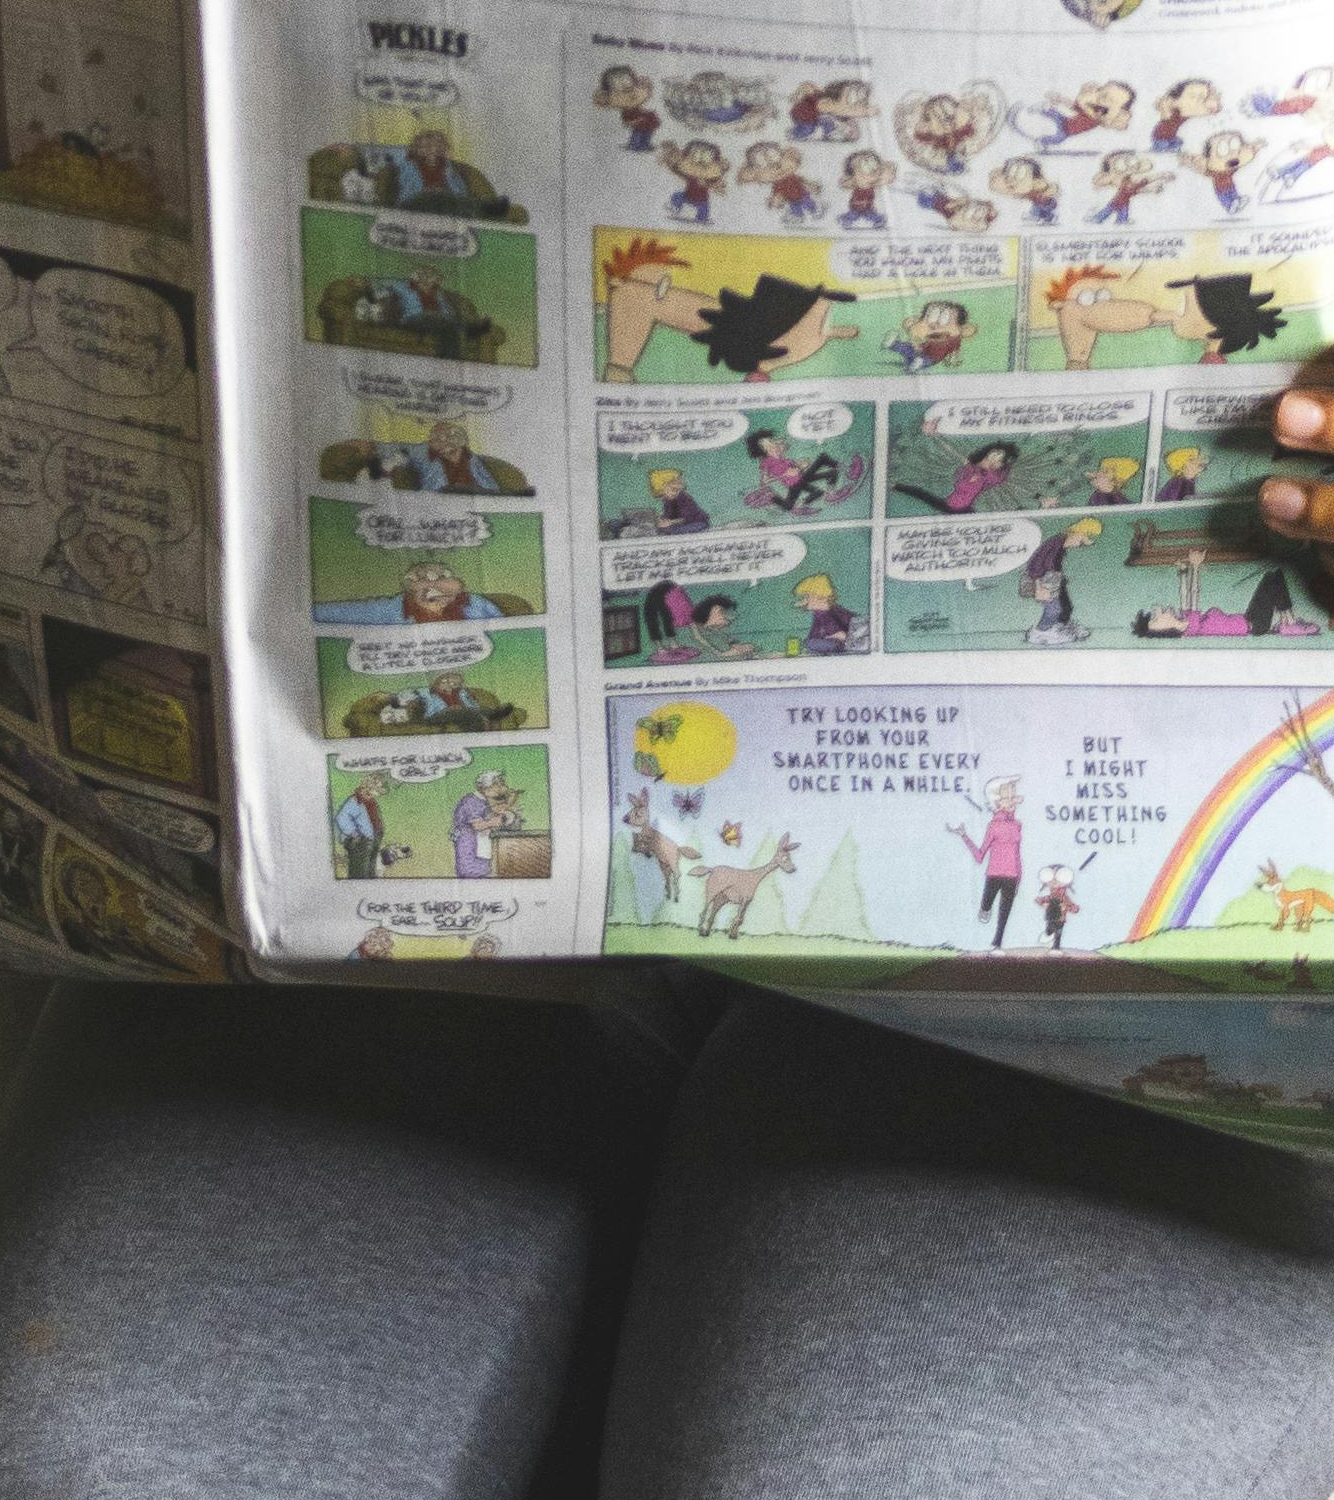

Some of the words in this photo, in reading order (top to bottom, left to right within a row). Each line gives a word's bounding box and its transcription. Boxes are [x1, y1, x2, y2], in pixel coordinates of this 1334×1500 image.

[786, 707, 824, 725] TRY
[835, 707, 926, 724] LOOKING
[936, 706, 960, 724] UP
[816, 729, 870, 746] FROM
[881, 730, 929, 746] YOUR
[1083, 736, 1121, 753] BUT
[772, 751, 907, 769] SMARTPHONE
[919, 753, 981, 770] EVERY
[1066, 759, 1073, 777] I
[1084, 760, 1147, 777] MIGHT
[788, 775, 840, 793] ONCE
[851, 775, 873, 792] IN
[883, 777, 895, 792] A
[904, 776, 970, 793] WHILE.
[1077, 783, 1128, 799] MISS
[1045, 805, 1167, 823] SOMETHING
[1074, 828, 1136, 845] COOL!
